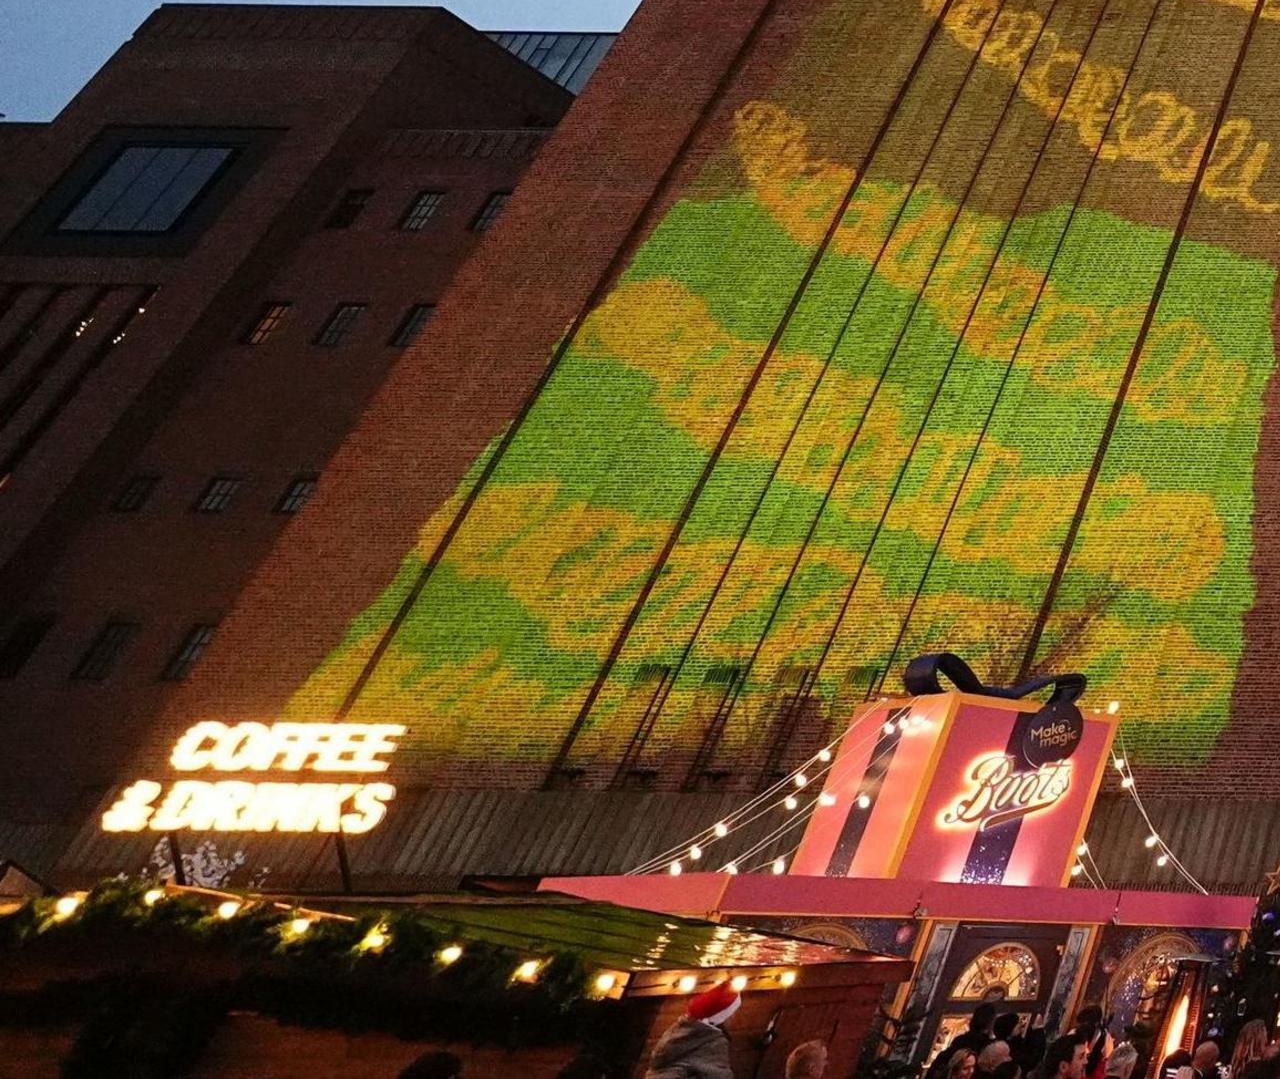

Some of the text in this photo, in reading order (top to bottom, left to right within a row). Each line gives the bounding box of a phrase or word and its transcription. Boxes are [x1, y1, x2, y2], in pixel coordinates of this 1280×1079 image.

[169, 720, 408, 772] COFFEE
[1030, 722, 1066, 741] Make
[1039, 726, 1078, 748] magic
[149, 779, 398, 835] DRINKS
[944, 755, 1072, 832] Boots
